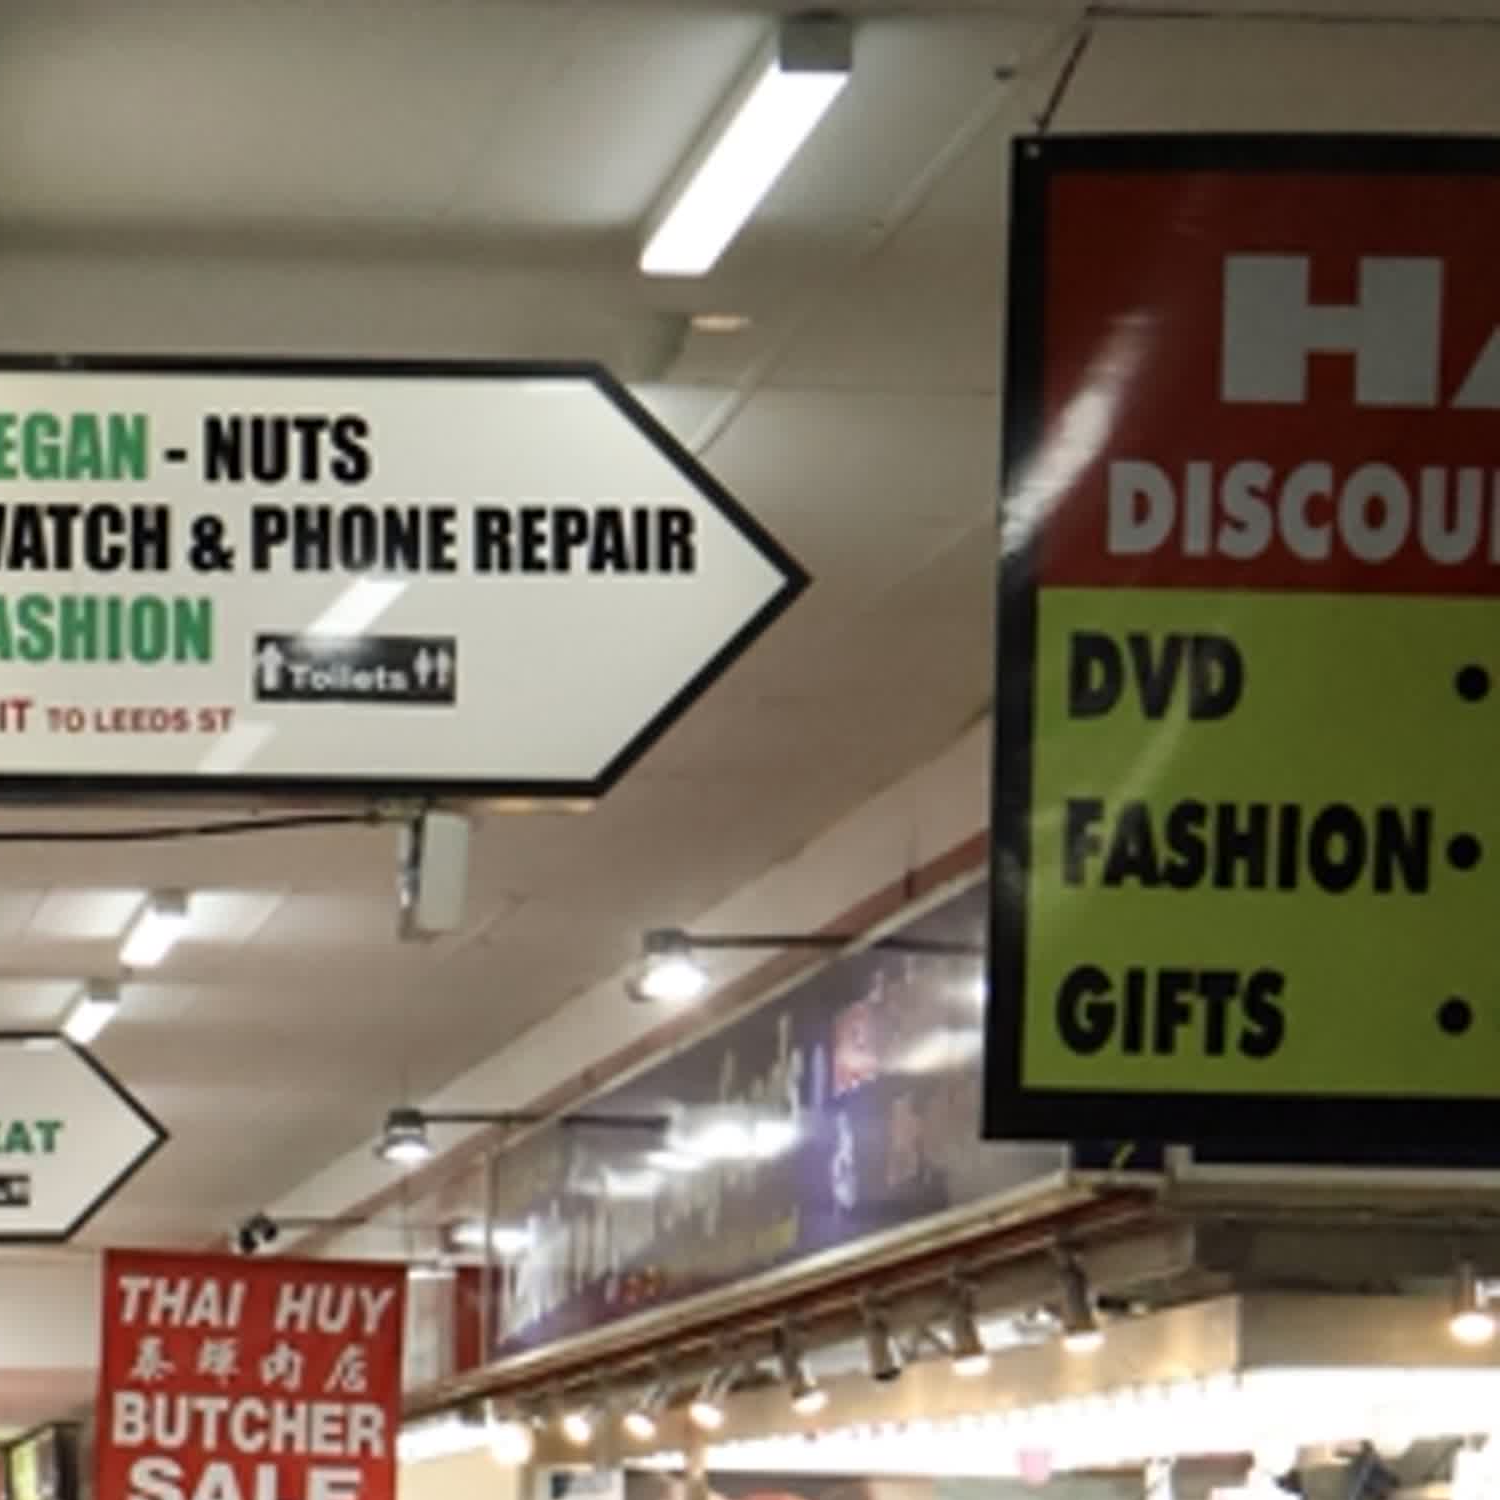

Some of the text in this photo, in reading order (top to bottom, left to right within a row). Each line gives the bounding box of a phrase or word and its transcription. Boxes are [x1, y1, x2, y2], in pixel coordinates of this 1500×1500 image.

[1221, 255, 1500, 408] H
[165, 449, 187, 462] -
[204, 415, 370, 484] NUTS
[190, 511, 235, 571] &
[251, 507, 457, 573] PHONE
[474, 507, 695, 574] REPAIR
[1107, 460, 1500, 565] DISCOU
[1067, 631, 1244, 720] DVD
[47, 708, 83, 732] TO
[95, 707, 189, 733] LEEDS
[198, 708, 235, 733] ST
[1062, 800, 1433, 894] FASHION
[1055, 966, 1285, 1057] GIFTS
[119, 1275, 394, 1335] THAI HUY
[112, 1392, 385, 1456] BUTCHER
